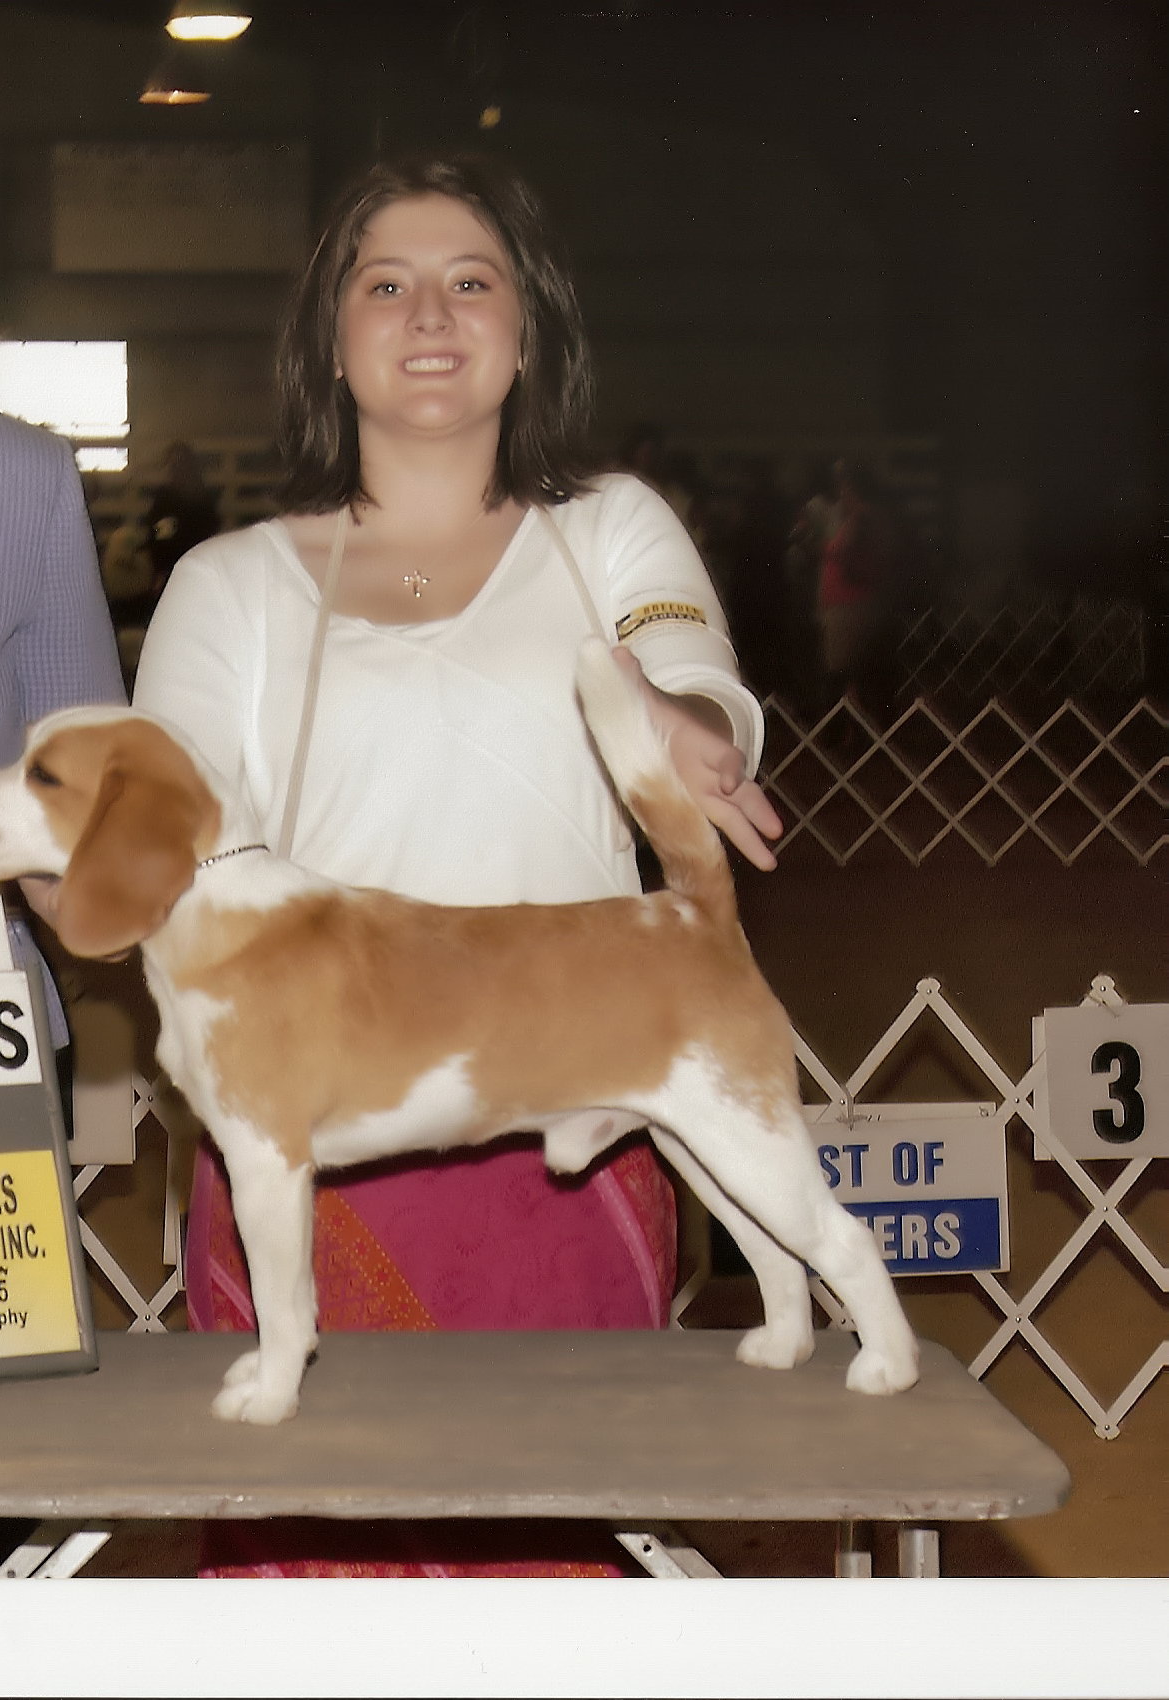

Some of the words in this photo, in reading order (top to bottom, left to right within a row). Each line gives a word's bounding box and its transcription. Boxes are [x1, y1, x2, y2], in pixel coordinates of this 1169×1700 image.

[1090, 1041, 1145, 1144] 3
[817, 1144, 869, 1189] ST
[892, 1141, 944, 1186] OF
[0, 1223, 46, 1260] INC.
[859, 1213, 960, 1260] ERS
